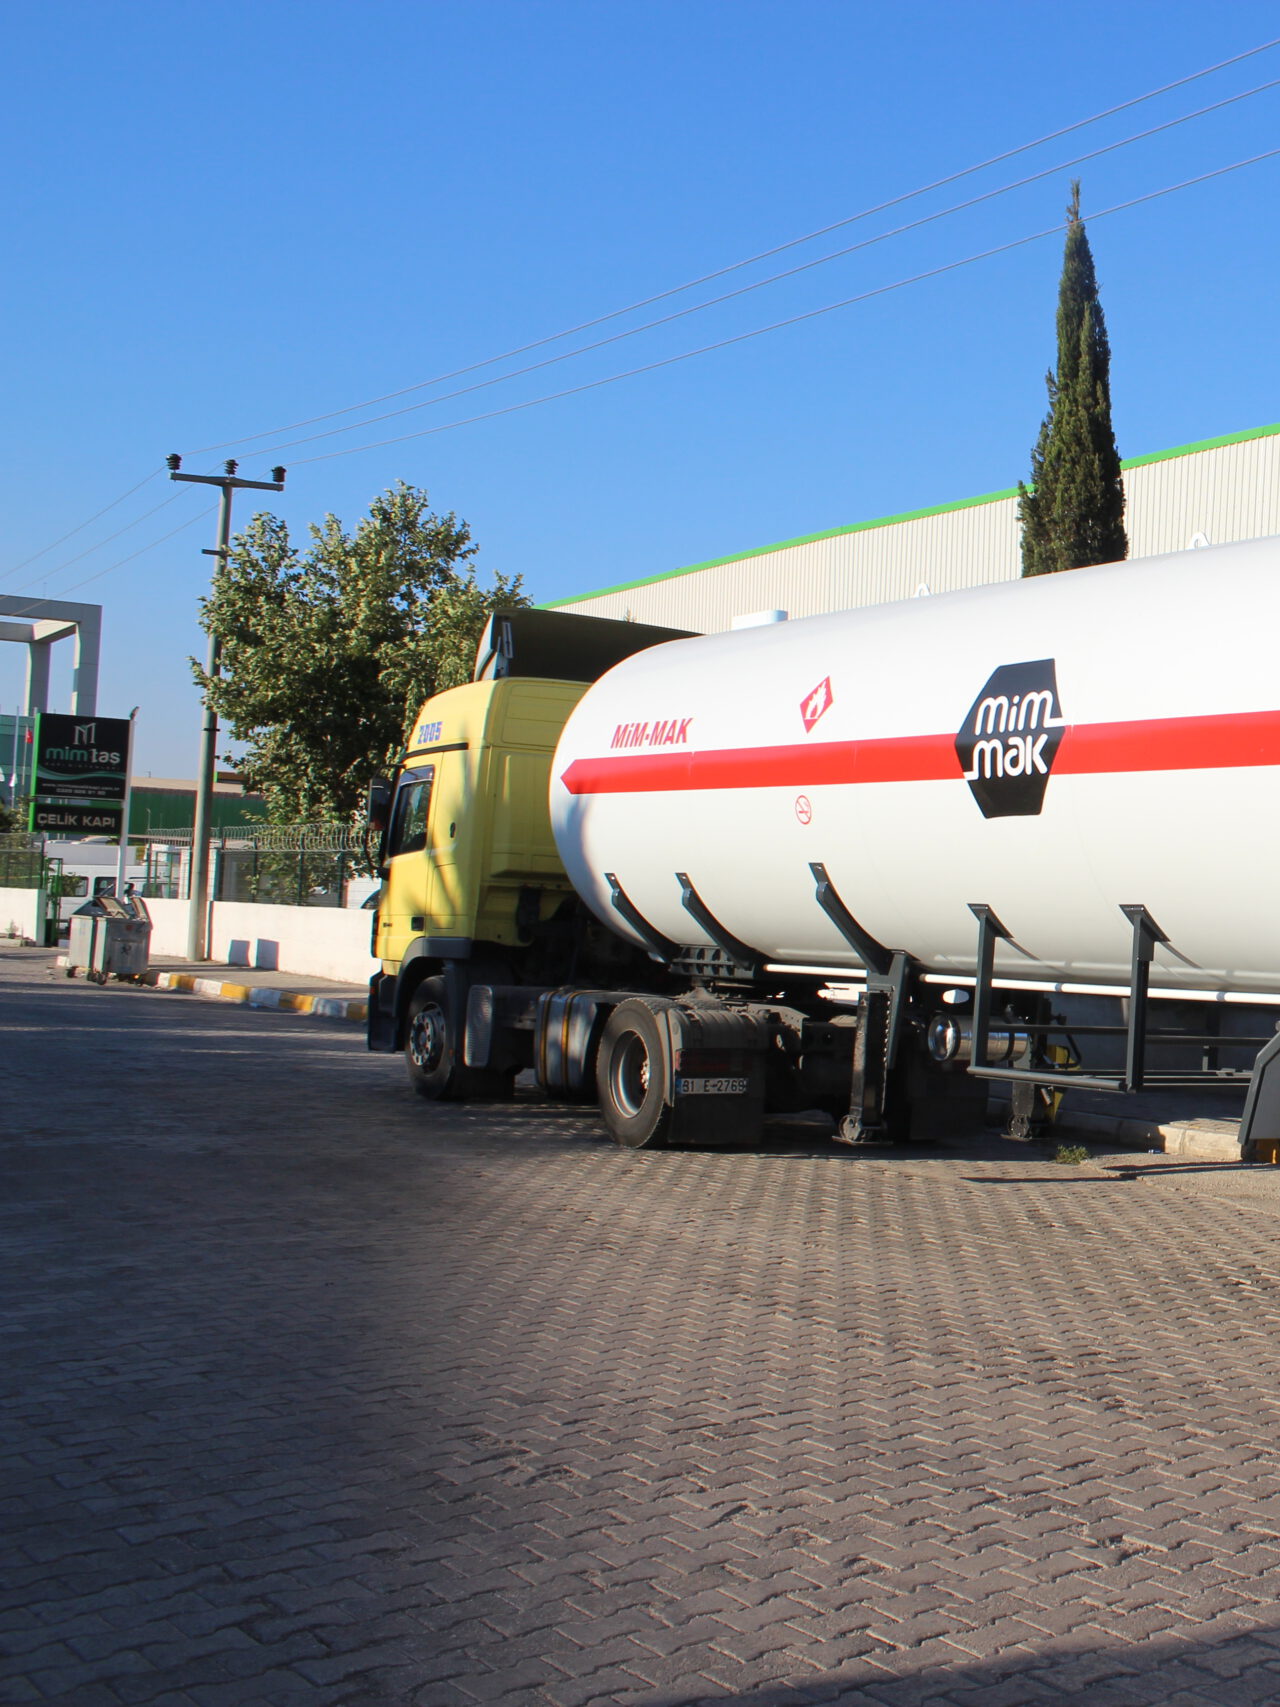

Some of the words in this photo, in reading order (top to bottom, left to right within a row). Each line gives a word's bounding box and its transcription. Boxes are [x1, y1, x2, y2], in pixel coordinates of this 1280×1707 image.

[416, 721, 443, 745] 2005
[37, 812, 78, 827] ÇELİK
[82, 815, 116, 828] KAPI
